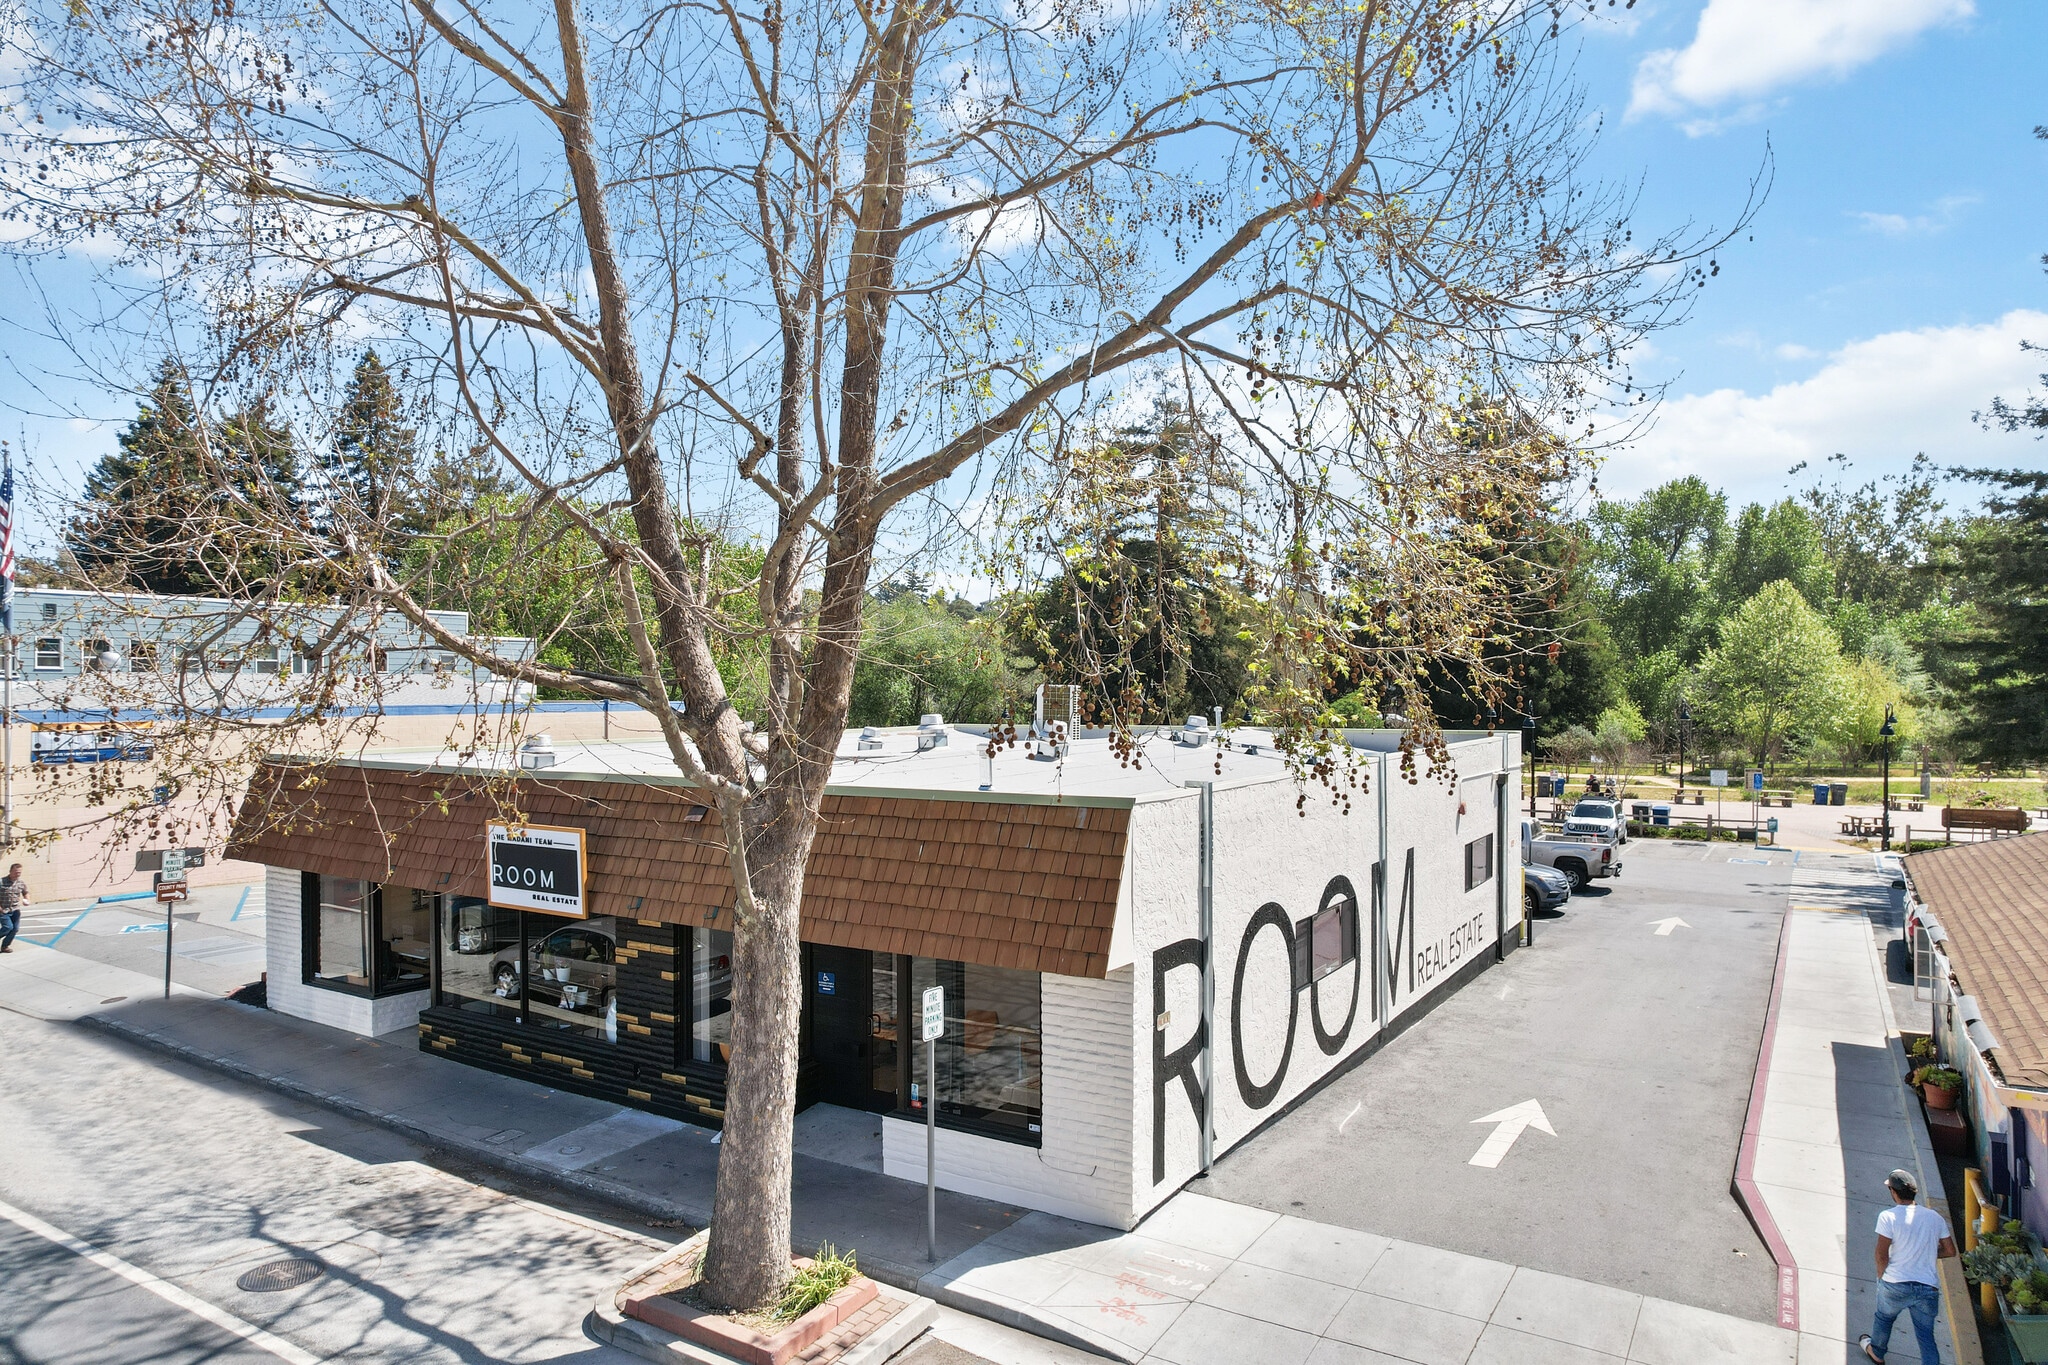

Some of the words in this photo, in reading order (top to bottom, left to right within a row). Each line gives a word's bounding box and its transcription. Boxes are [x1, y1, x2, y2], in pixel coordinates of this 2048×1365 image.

[535, 838, 553, 846] TEAM
[493, 864, 554, 889] ROOM
[552, 897, 578, 906] ESTATE
[928, 992, 938, 1002] FIVE
[926, 1002, 940, 1014] MINUTE
[924, 1012, 942, 1024] PARKING
[1152, 847, 1415, 1187] ROOM
[1417, 938, 1447, 987] REAL
[1449, 912, 1483, 964] ESTATE
[928, 1025, 938, 1035] ONLY
[1782, 1297, 1794, 1310] FIRE
